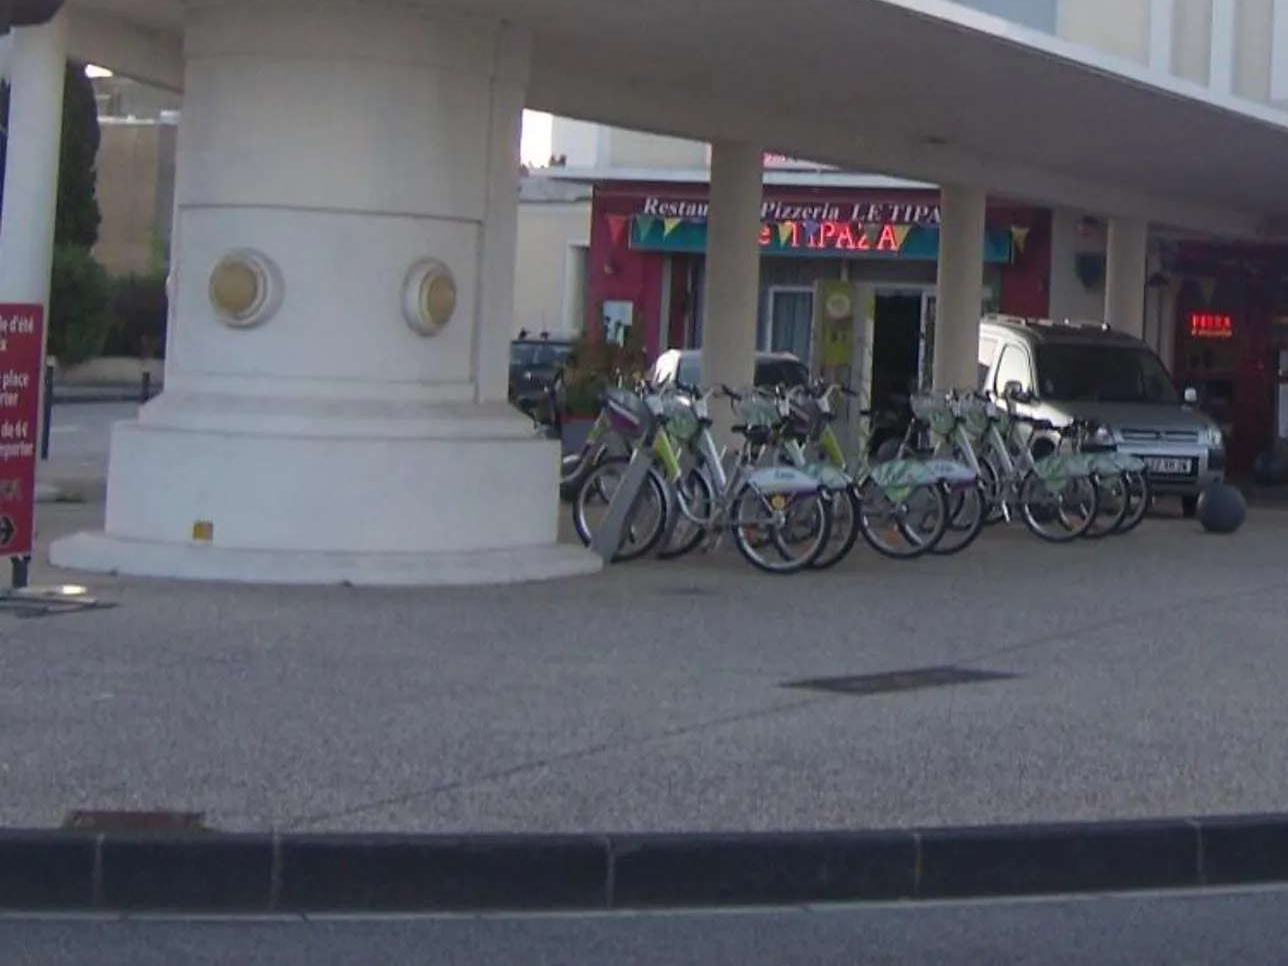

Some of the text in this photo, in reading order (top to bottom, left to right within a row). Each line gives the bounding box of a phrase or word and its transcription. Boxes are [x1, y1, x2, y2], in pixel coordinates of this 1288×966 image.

[643, 197, 940, 223] Restau Pizzeria LE TIPA
